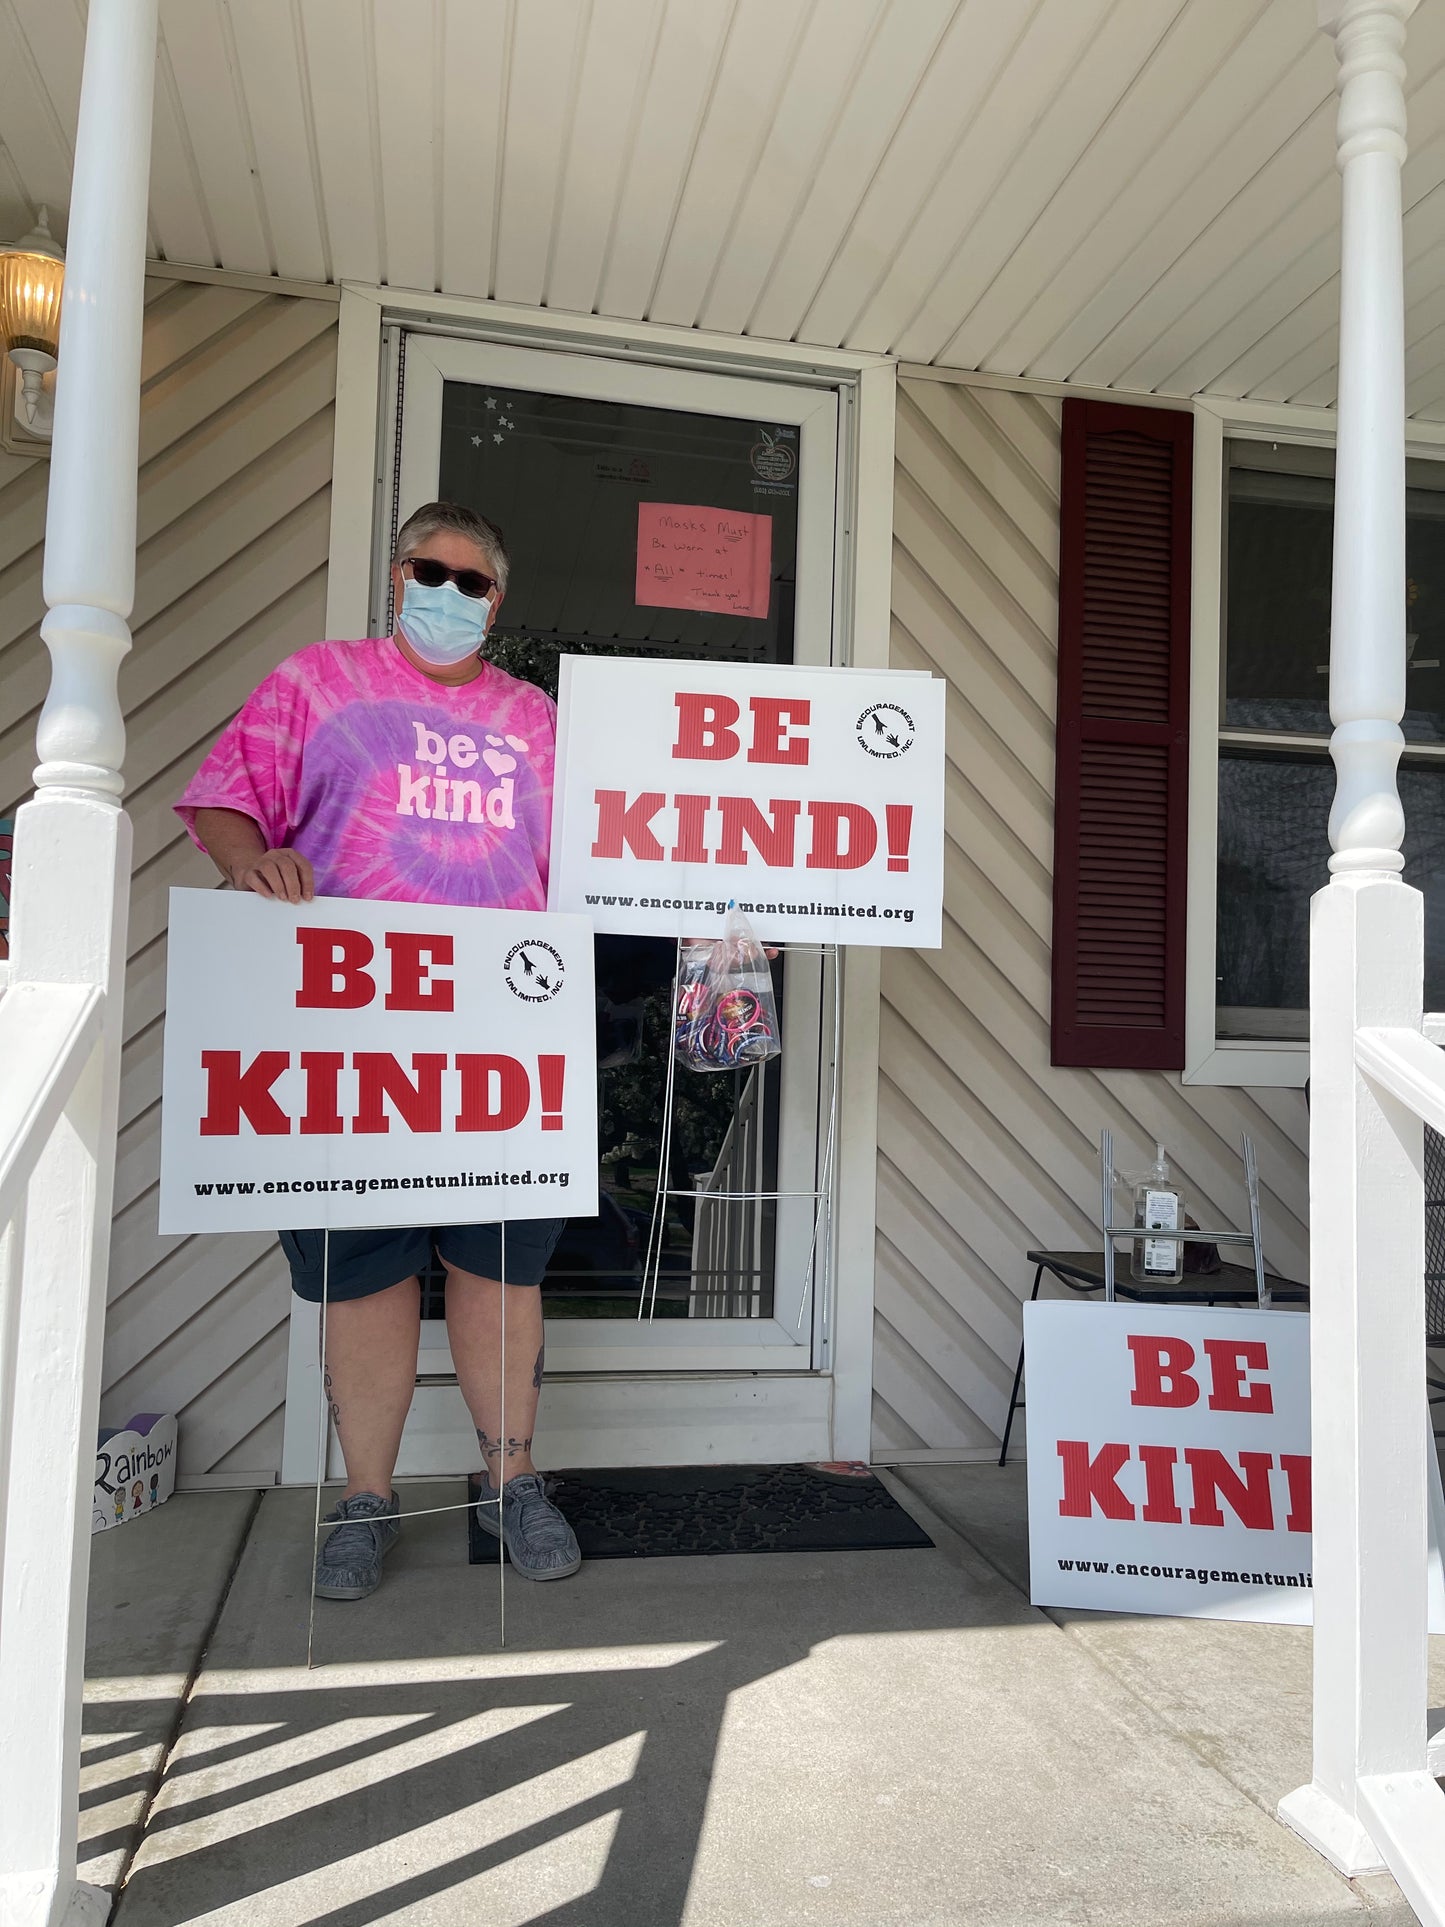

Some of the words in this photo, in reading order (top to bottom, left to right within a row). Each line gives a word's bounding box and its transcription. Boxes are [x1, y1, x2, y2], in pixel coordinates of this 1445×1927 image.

[659, 516, 706, 532] Masks
[717, 522, 749, 537] Must
[674, 542, 703, 552] worn
[715, 546, 728, 555] at
[690, 587, 721, 598] Thank
[673, 692, 811, 765] BE
[856, 703, 915, 732] ENCOURAGEMENT
[412, 721, 479, 769] be
[901, 738, 914, 754] INC.
[396, 763, 516, 830] kind
[592, 790, 912, 872] KIND!
[585, 895, 914, 923] www.encouragmentunlimited.org
[296, 927, 454, 1012] BE
[503, 939, 565, 973] ENCOURAGEMENT
[550, 979, 564, 997] INC.
[200, 1050, 566, 1136] KIND!
[194, 1171, 570, 1195] www.encouragementunlimited.org
[1127, 1335, 1274, 1413] BE
[94, 1440, 174, 1495] Rainbow
